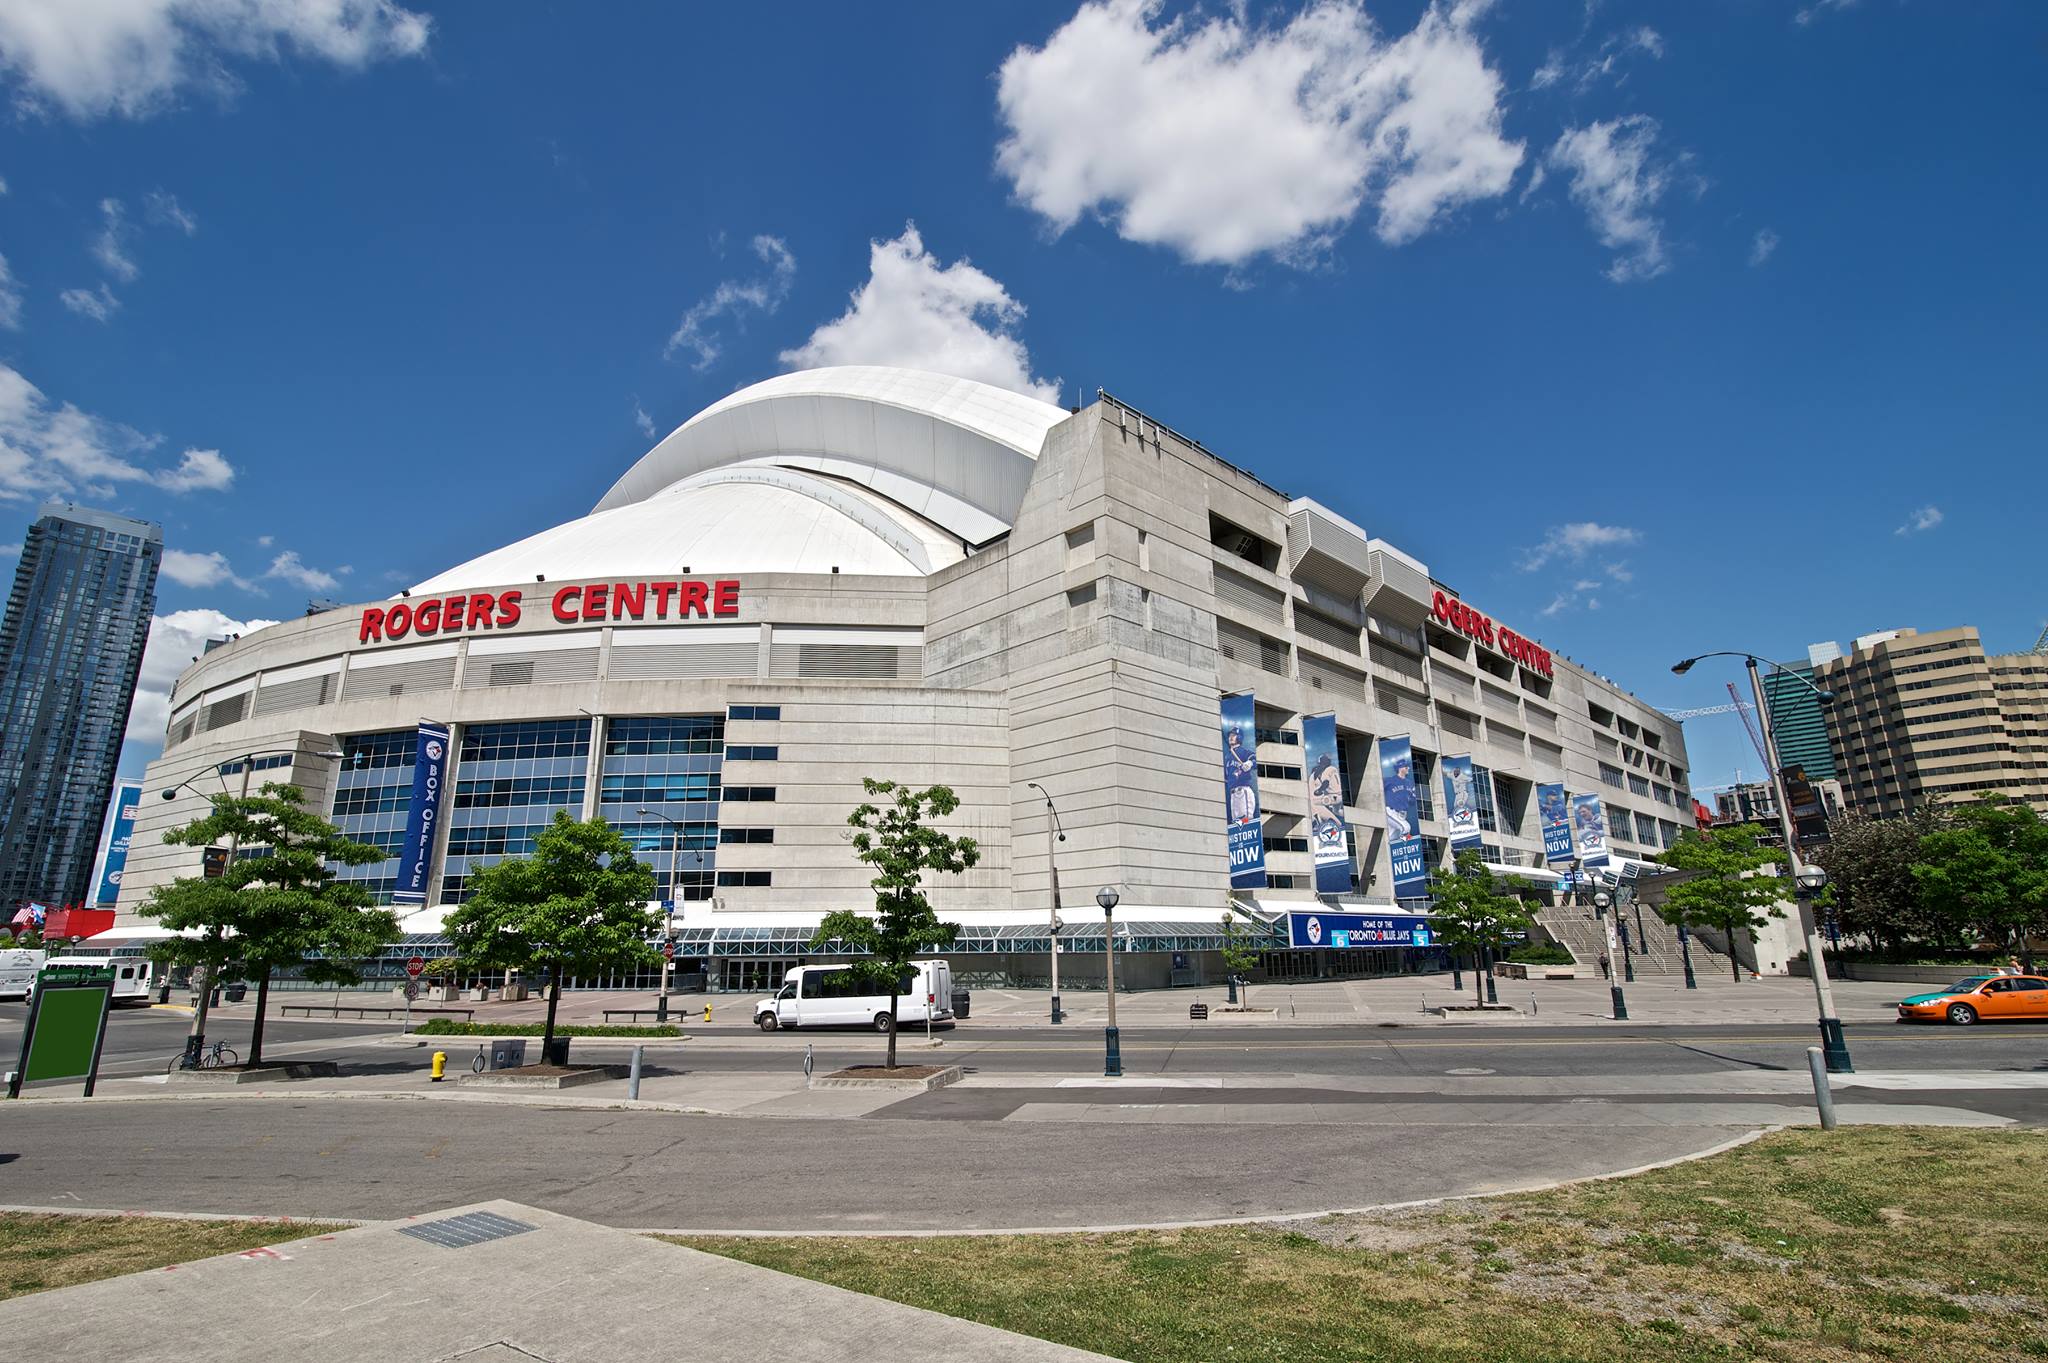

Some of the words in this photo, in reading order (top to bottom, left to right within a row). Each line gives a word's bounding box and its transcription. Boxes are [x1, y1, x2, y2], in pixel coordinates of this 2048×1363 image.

[359, 590, 522, 642] ROGERS
[551, 580, 741, 622] CENTRE
[1431, 590, 1495, 645] OGERS
[1497, 626, 1554, 678] CENTRE
[425, 764, 438, 802] BOX
[1228, 829, 1259, 844] HISTORY
[1544, 828, 1568, 838] HISTORY
[411, 808, 434, 888] OFFICE
[1392, 843, 1420, 856] HISTORY
[1546, 838, 1569, 853] NOW
[1230, 845, 1260, 866] NOW
[1394, 858, 1421, 876] NOW
[1362, 921, 1376, 929] HOME
[1377, 921, 1383, 929] OF
[1384, 921, 1393, 929] THE
[1336, 936, 1345, 947] 6
[1383, 930, 1396, 940] BLUE
[1397, 930, 1409, 940] JAYS
[1417, 936, 1425, 947] 5
[408, 962, 424, 970] STOP
